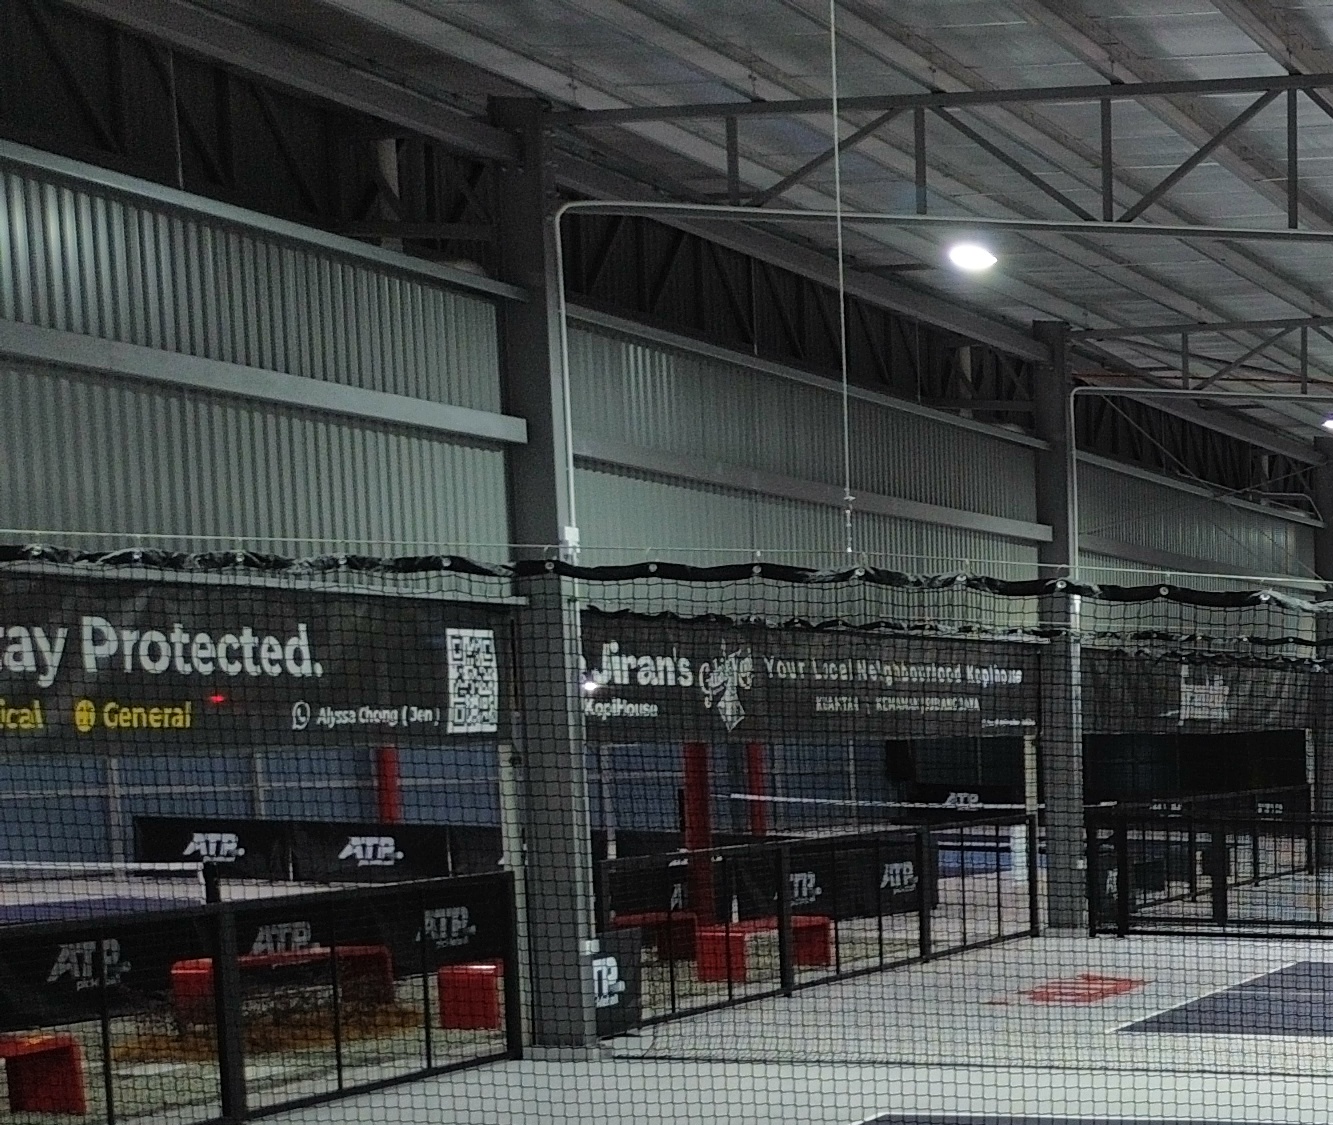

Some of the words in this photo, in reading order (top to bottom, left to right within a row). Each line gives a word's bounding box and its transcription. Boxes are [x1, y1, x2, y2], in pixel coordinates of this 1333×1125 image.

[0, 625, 68, 688] ay
[81, 615, 323, 678] Protected.
[103, 701, 192, 729] General
[316, 706, 356, 729] Alyssa
[358, 705, 399, 728] Chong
